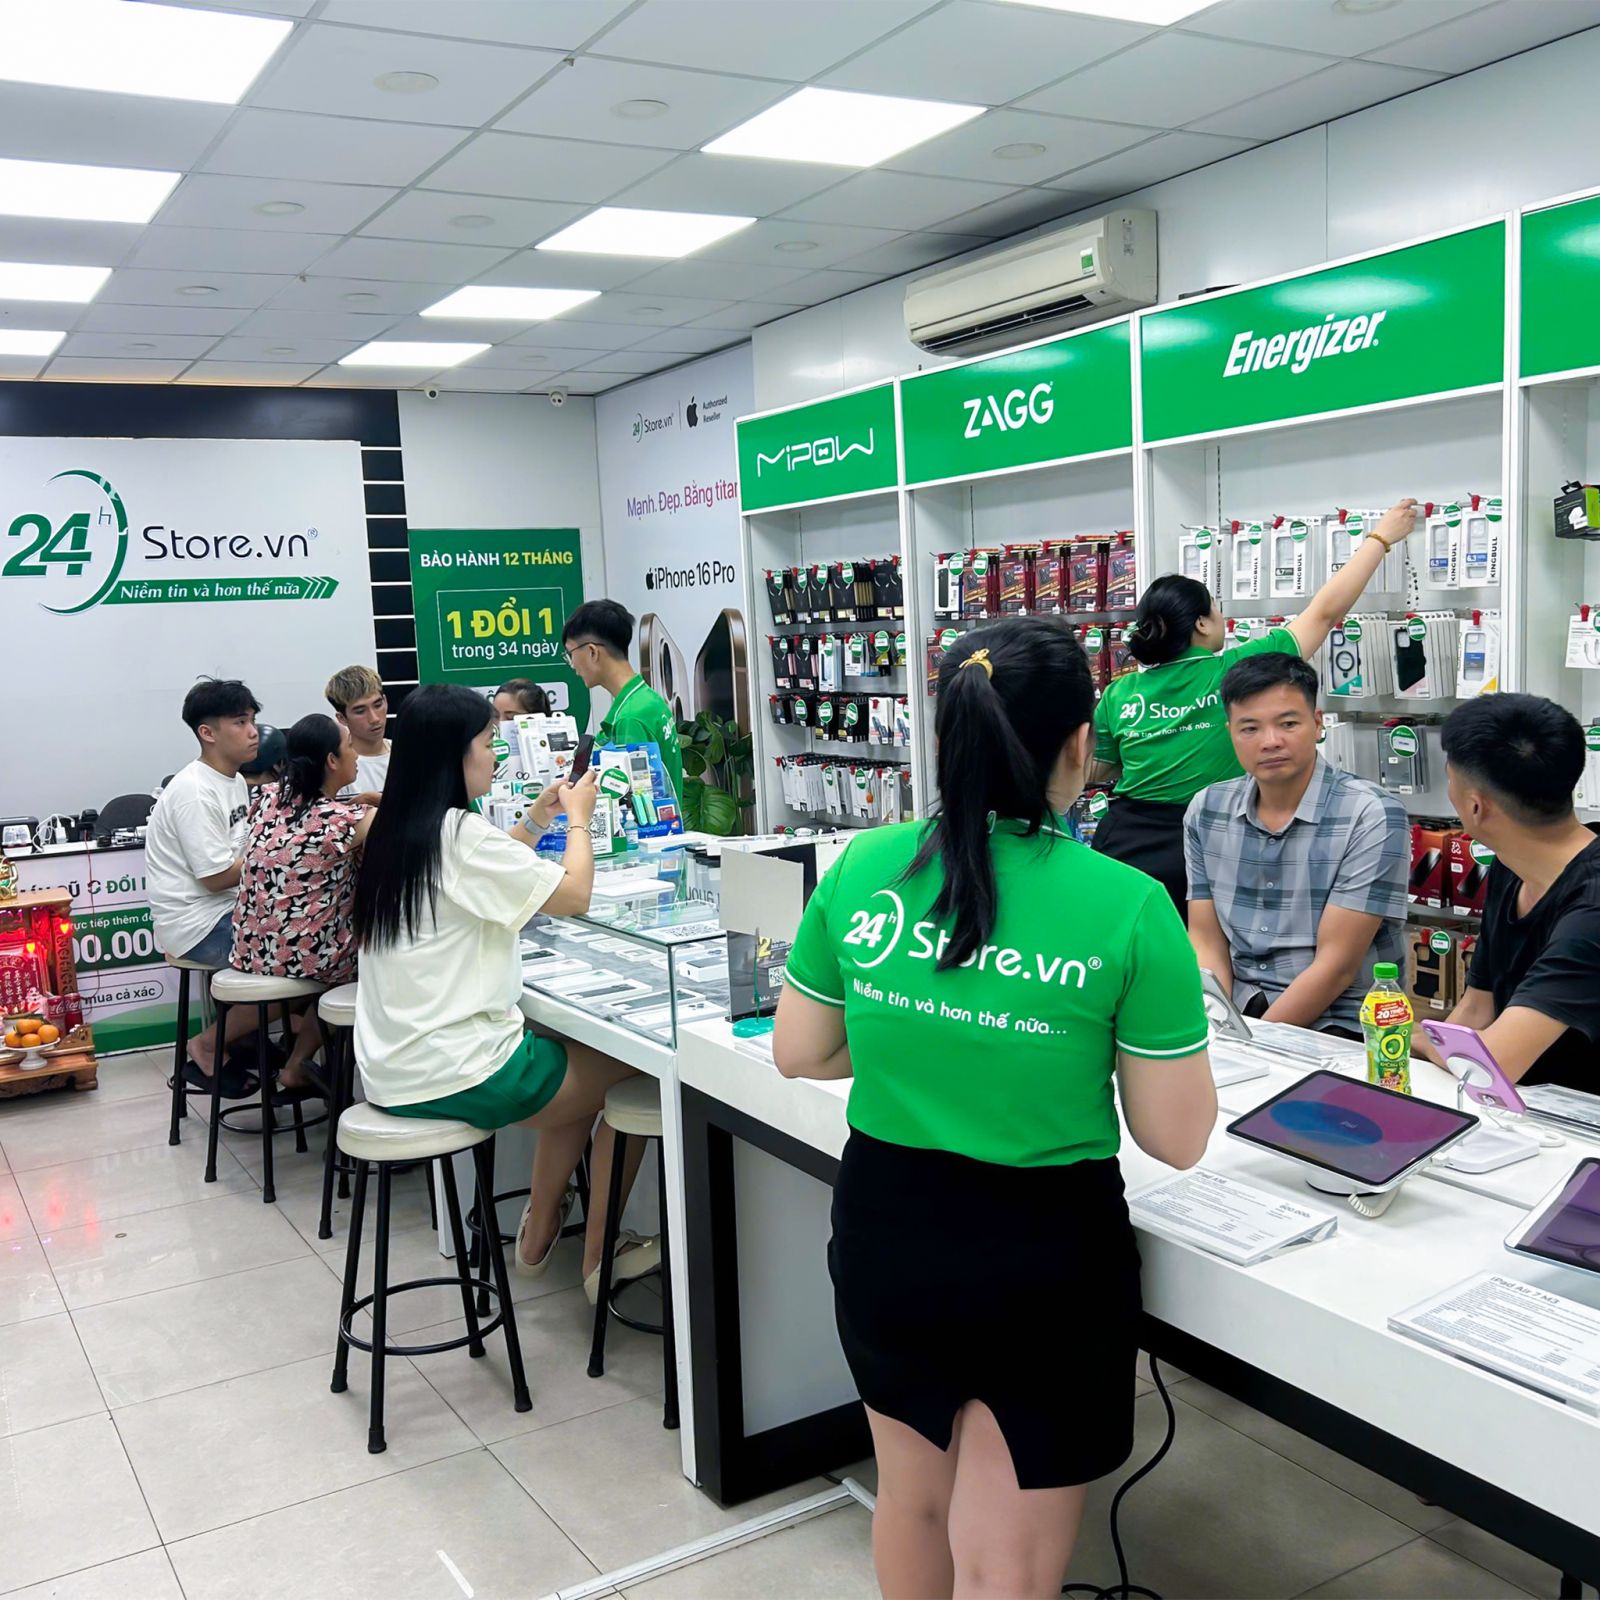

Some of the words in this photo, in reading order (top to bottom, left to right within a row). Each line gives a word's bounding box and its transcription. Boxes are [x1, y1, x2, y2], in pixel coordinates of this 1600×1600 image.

[1223, 310, 1387, 377] Energizer
[702, 395, 728, 410] Authorized
[963, 381, 1054, 439] ZAGG
[703, 411, 721, 423] Reseller
[627, 494, 657, 521] Mạnh.
[658, 489, 683, 515] Đẹp.
[684, 479, 713, 508] Bằng
[456, 550, 500, 566] HÀNH
[503, 552, 520, 565] 12
[522, 549, 574, 564] THÁNG
[654, 567, 695, 590] iPhone
[696, 561, 711, 586] 16
[713, 560, 735, 585] Pro
[120, 581, 162, 599] Niềm
[168, 583, 188, 598] tin
[193, 582, 210, 598] và
[214, 583, 242, 597] hơn
[247, 580, 273, 596] thế
[274, 582, 300, 596] nữa
[446, 610, 462, 639] 1
[470, 596, 531, 638] ĐỔI
[538, 608, 553, 635] 1
[452, 644, 495, 660] trong
[498, 641, 519, 656] 34
[522, 638, 559, 659] ngày
[106, 874, 137, 893] ĐỔI
[90, 916, 110, 929] tiếp
[112, 913, 139, 925] thêm
[84, 995, 113, 1006] mua
[133, 986, 156, 999] xác
[853, 977, 884, 1003] Niềm
[888, 989, 910, 1009] tin
[915, 996, 935, 1014] và
[940, 1002, 972, 1023] hơn
[978, 1011, 1009, 1030] thế
[1490, 1276, 1516, 1288] iPad
[1516, 1285, 1532, 1294] Air
